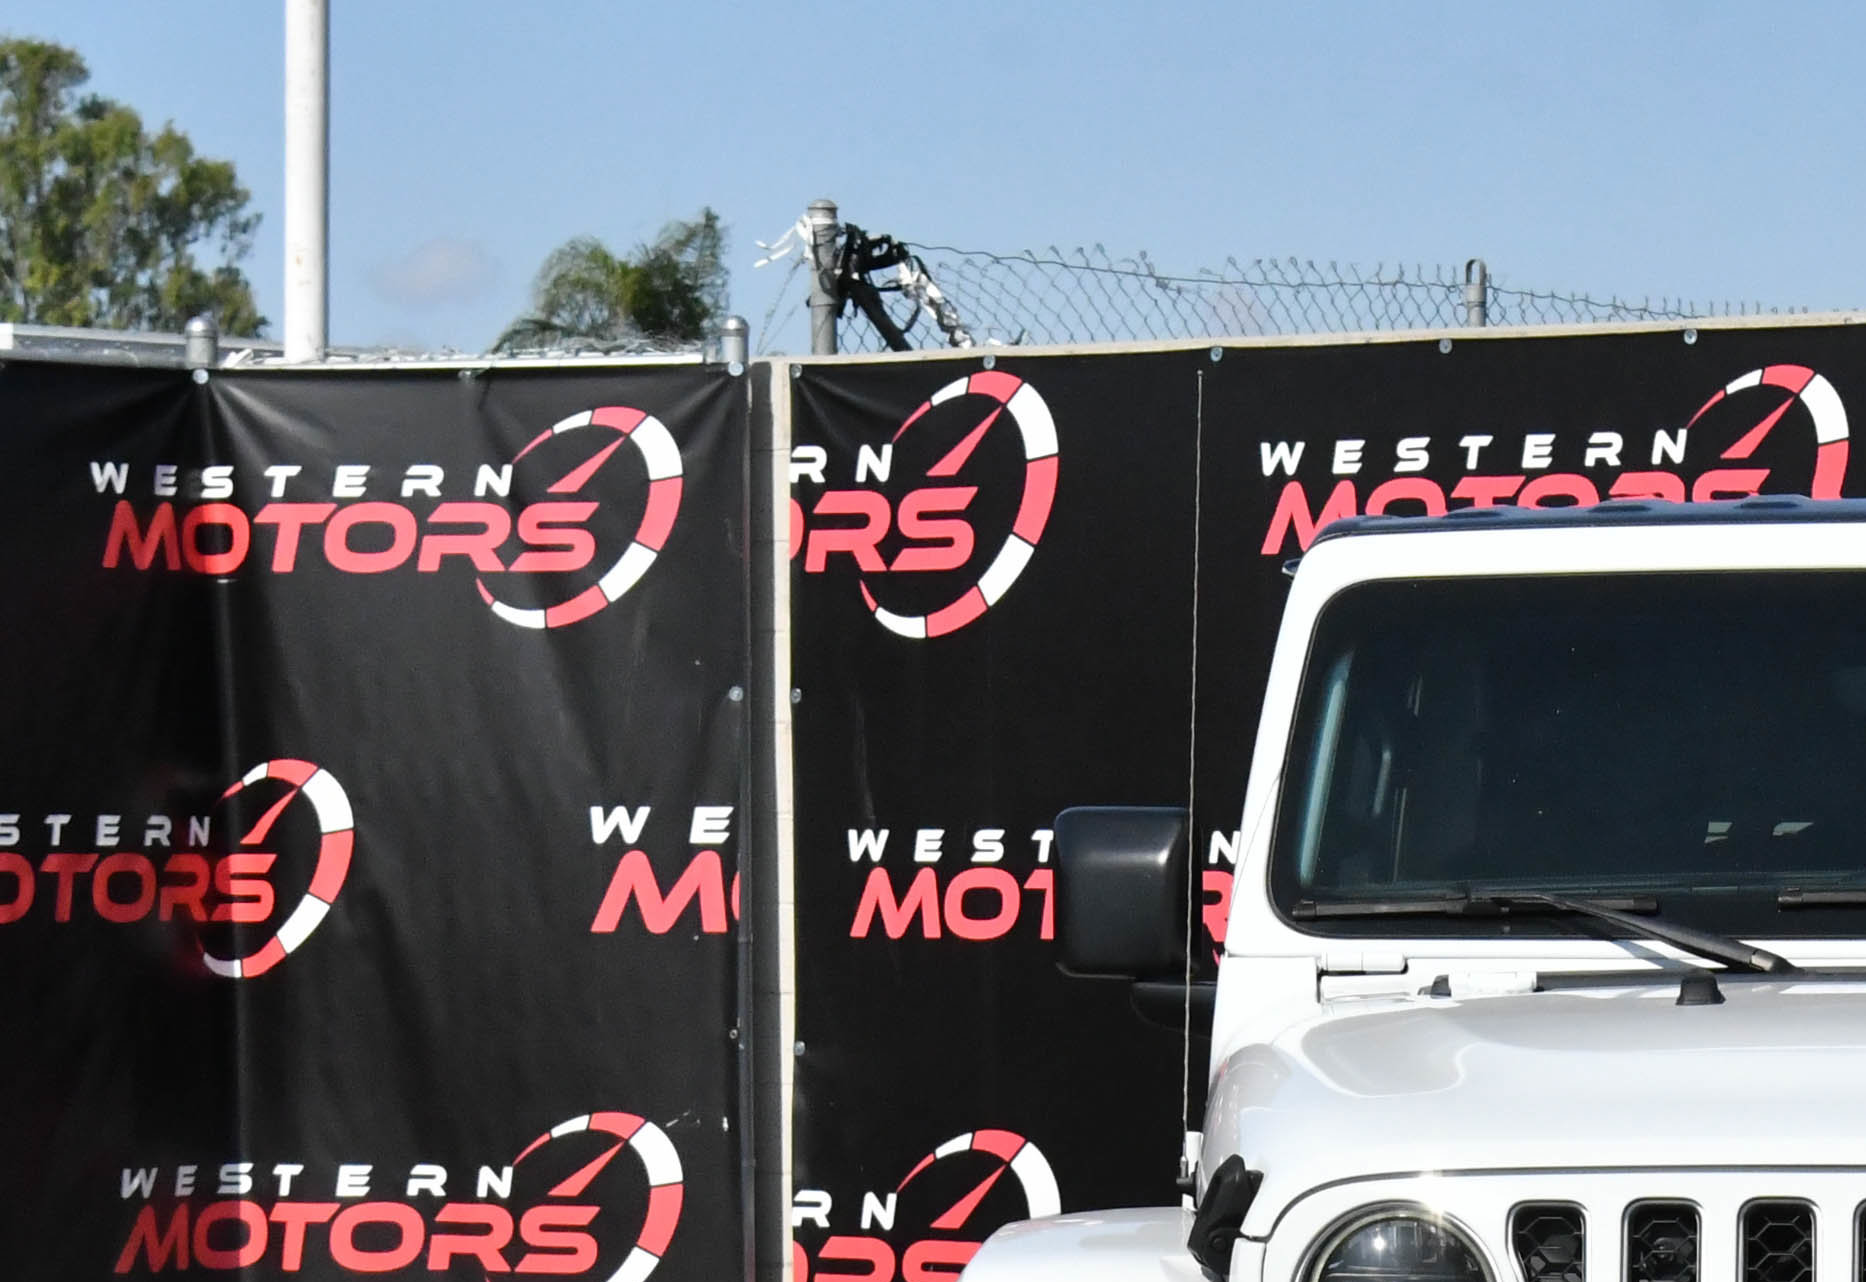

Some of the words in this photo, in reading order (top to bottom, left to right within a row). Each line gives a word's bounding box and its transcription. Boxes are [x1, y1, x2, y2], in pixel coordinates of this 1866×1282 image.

[91, 462, 513, 500] WESTERN
[1261, 429, 1687, 476] WESTERN
[104, 500, 598, 575] MOTORS
[790, 487, 978, 573] RS
[592, 850, 739, 934] M
[121, 1161, 514, 1200] WESTERN
[115, 1200, 600, 1276] MOTORS
